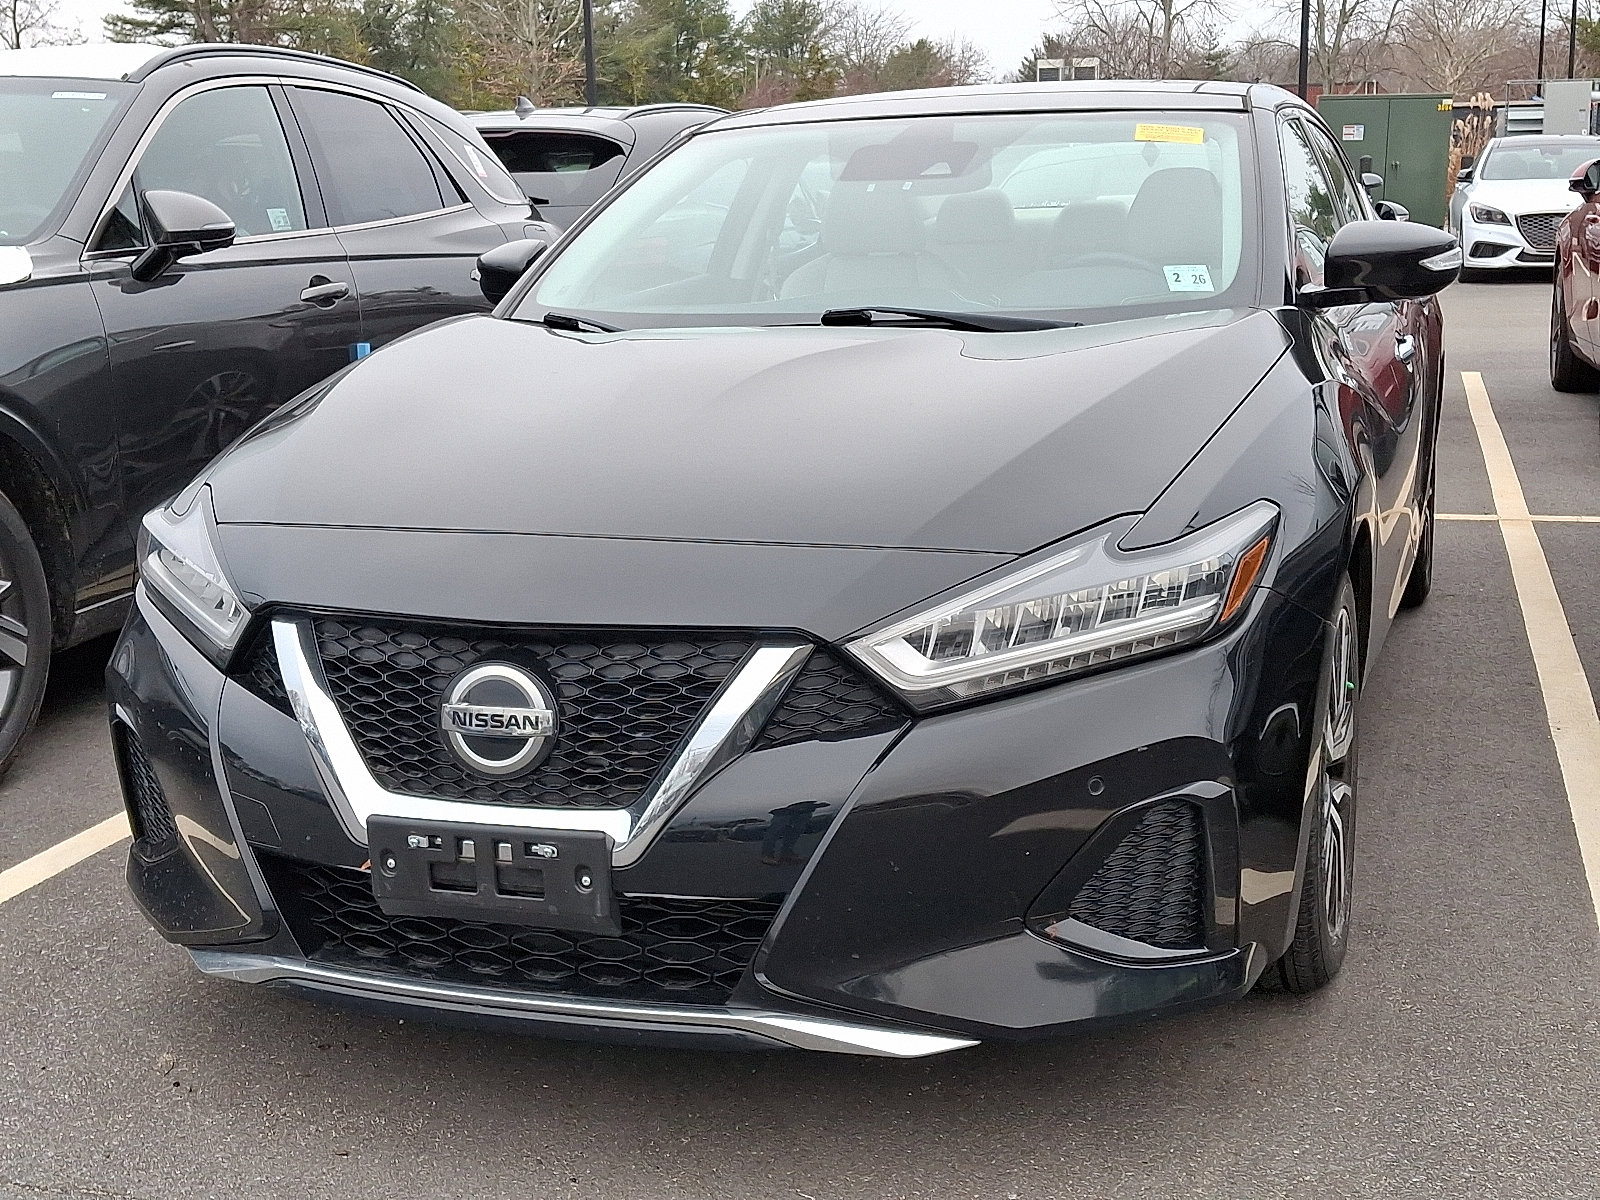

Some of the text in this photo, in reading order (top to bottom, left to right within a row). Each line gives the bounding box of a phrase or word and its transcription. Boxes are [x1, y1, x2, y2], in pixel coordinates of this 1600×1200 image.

[1172, 272, 1206, 284] 2 26
[452, 710, 540, 730] NISSAN
